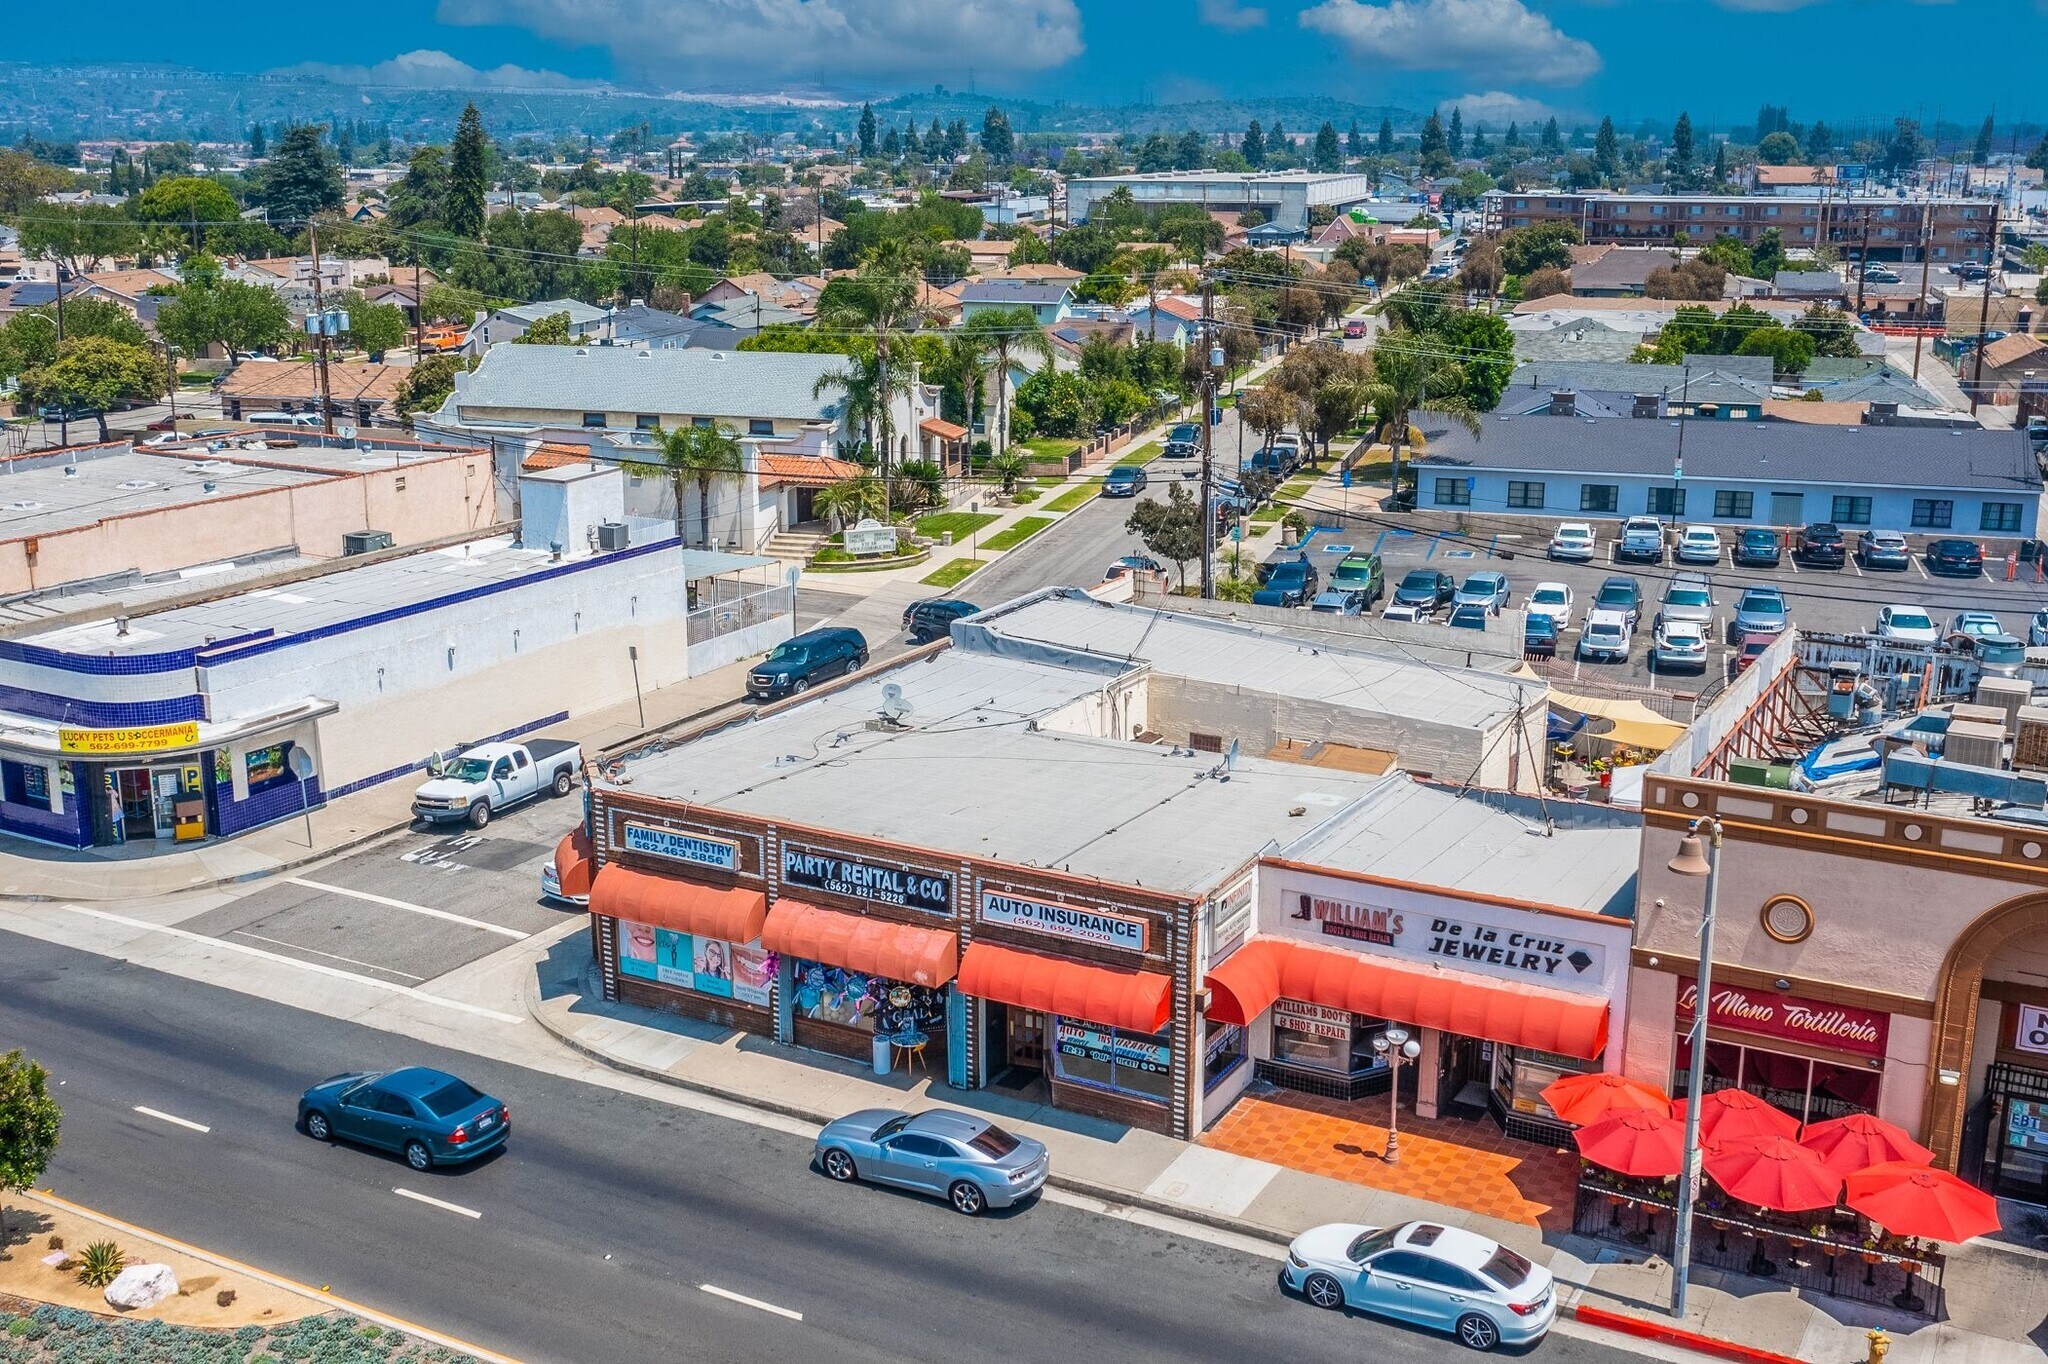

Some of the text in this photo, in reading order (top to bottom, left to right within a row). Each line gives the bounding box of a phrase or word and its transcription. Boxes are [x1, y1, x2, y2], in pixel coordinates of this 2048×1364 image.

[63, 732, 90, 741] LUCKY
[93, 732, 115, 741] PETS
[89, 740, 168, 750] 562-699-7799
[627, 827, 732, 857] FAMILY DENTISTRY
[634, 840, 724, 865] 562.463.5856
[786, 851, 946, 902] PARTY RENTAL & CO.
[824, 879, 904, 904] (562) 821-5228
[988, 896, 1137, 938] AUTO INSURANCE
[1012, 916, 1111, 941] (562) 692-2020
[1313, 899, 1404, 935] WILLIAM'S
[1430, 918, 1565, 954] De la Cruz
[1428, 936, 1562, 974] JEWELRY
[1275, 1000, 1319, 1018] WILLIAMS
[1711, 990, 1774, 1022] Mano
[1060, 1025, 1086, 1038] AUTO
[1280, 1016, 1346, 1040] & SHOE REPAIR
[2012, 1113, 2040, 1128] EBT
